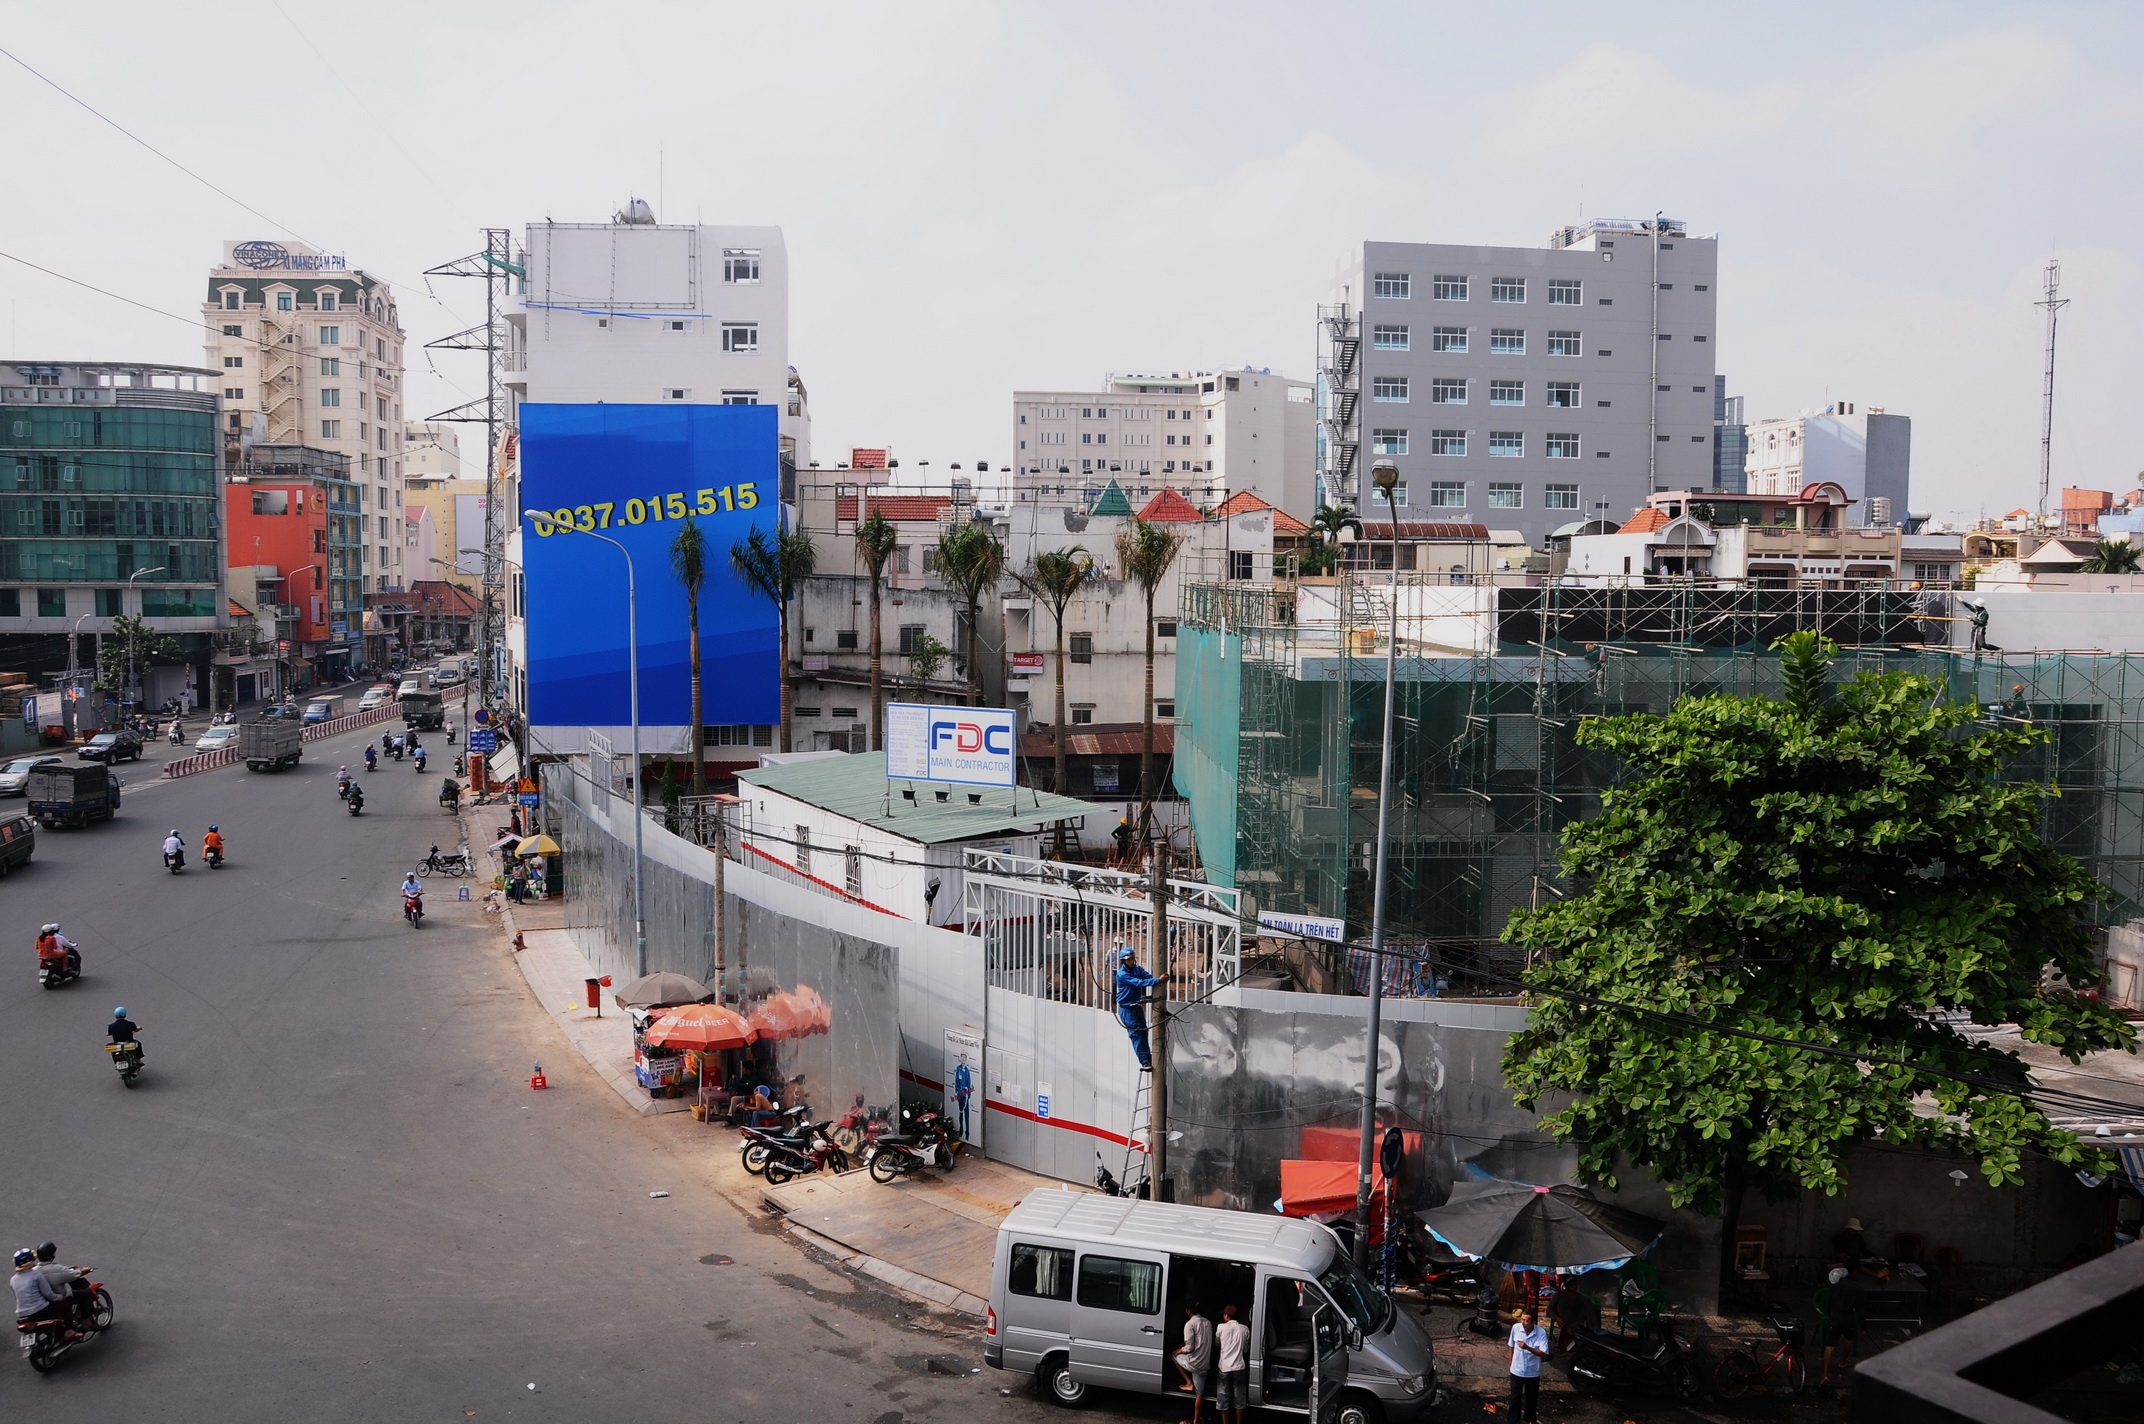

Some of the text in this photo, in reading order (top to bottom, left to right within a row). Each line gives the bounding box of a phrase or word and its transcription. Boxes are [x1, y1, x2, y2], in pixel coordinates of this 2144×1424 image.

[235, 250, 287, 259] VINACONEX
[531, 482, 760, 538] 0937.015.515
[931, 721, 1010, 755] FDC
[931, 757, 1010, 772] MAIN CONTRACTOR
[1305, 922, 1324, 937] TRÊN
[1326, 923, 1340, 939] HẾT
[705, 1017, 730, 1027] BEER
